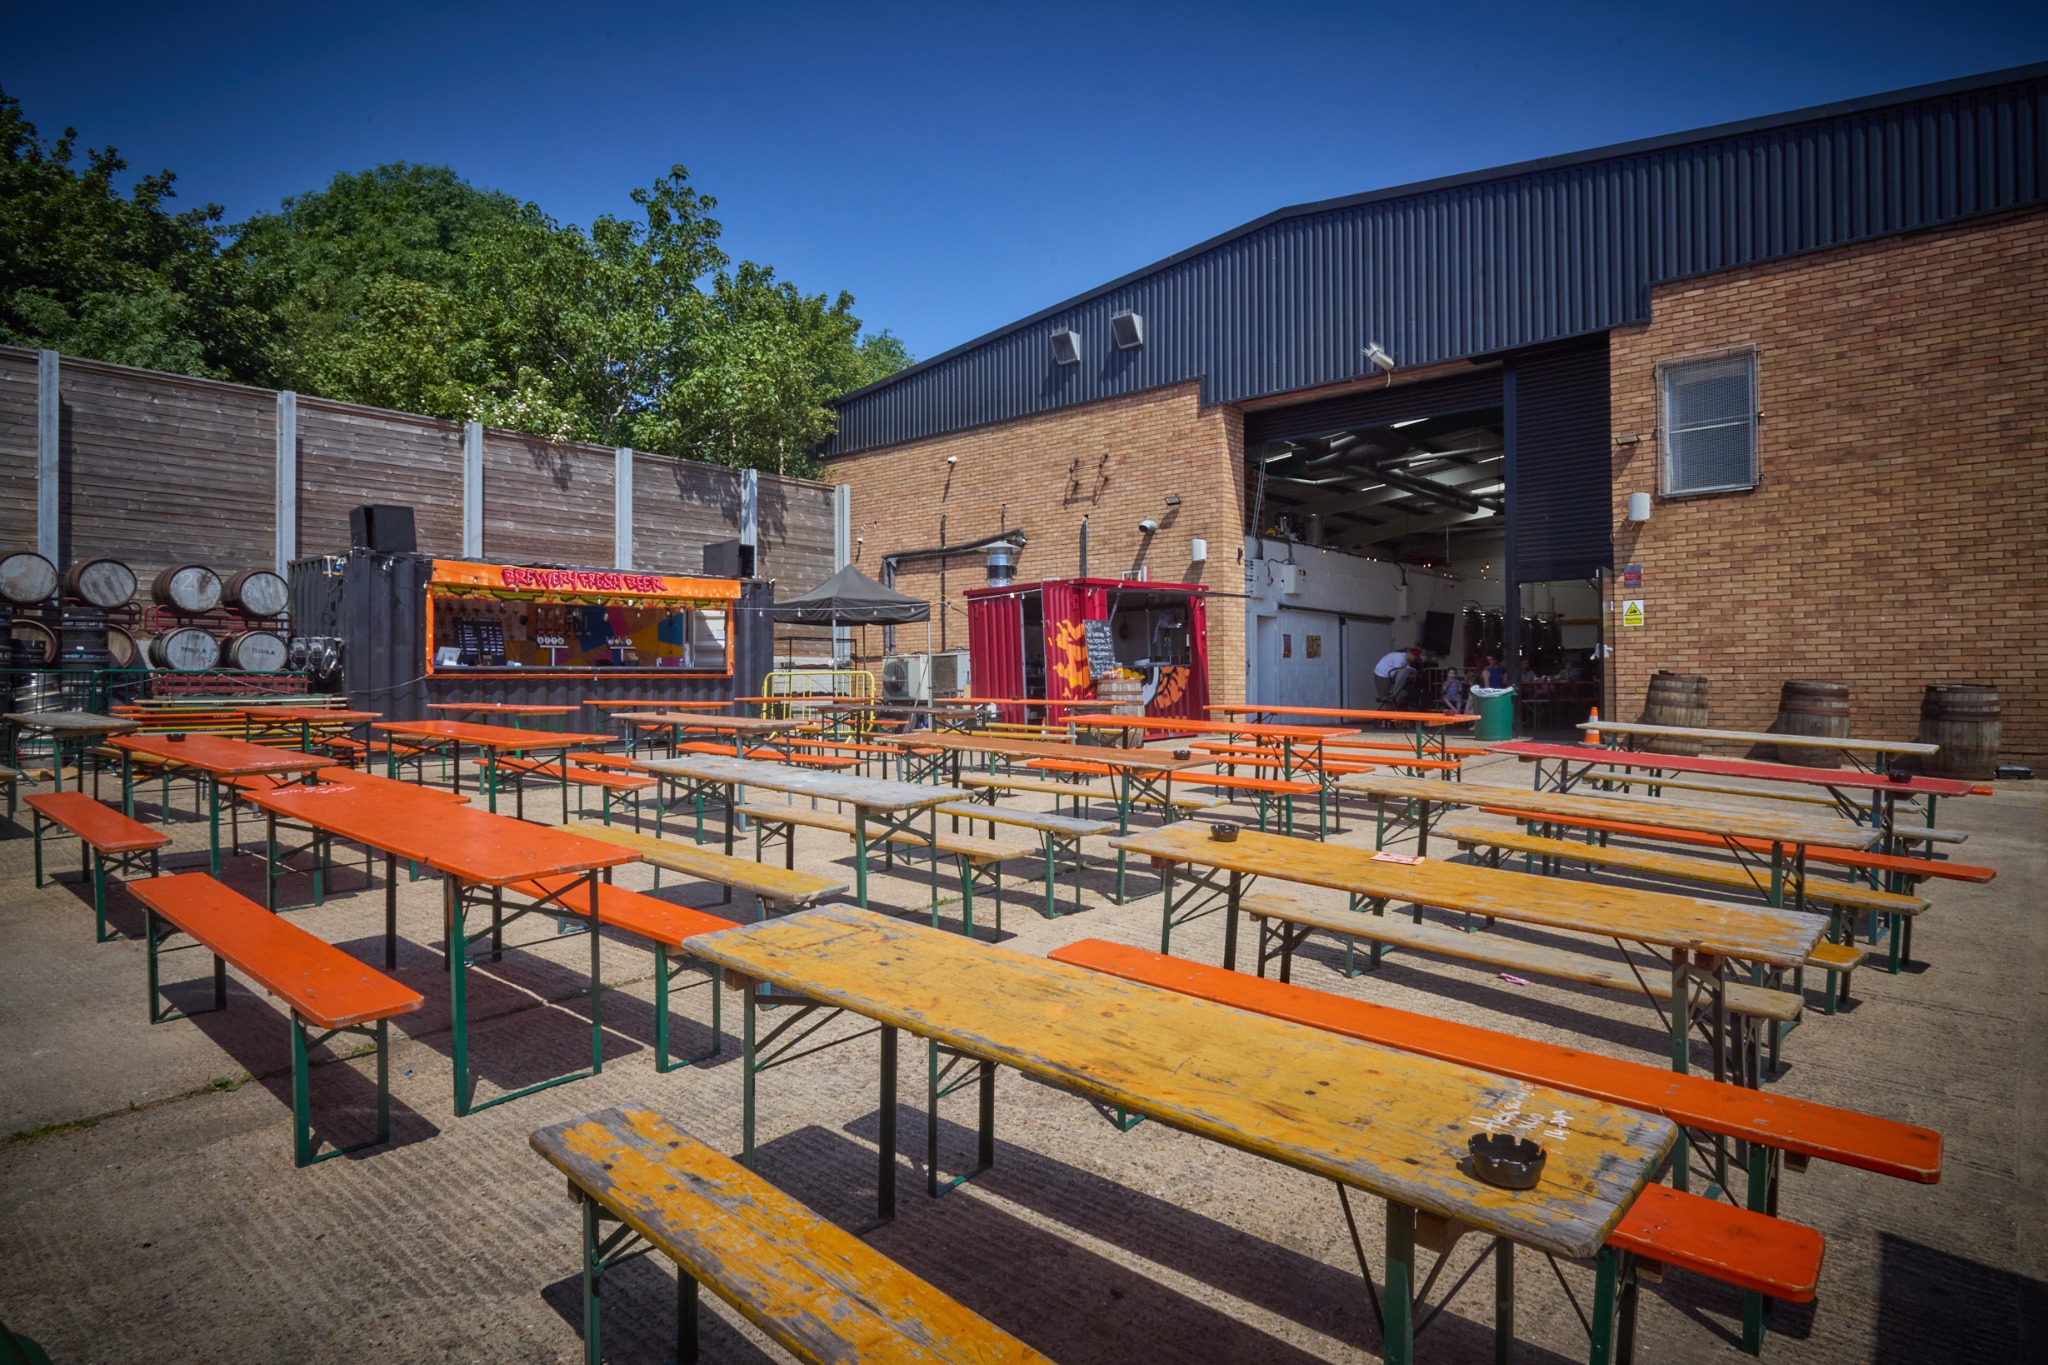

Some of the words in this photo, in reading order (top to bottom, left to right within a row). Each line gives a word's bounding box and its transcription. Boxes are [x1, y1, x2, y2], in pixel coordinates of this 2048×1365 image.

[180, 573, 193, 590] 2
[501, 568, 578, 591] BREWERY
[578, 572, 623, 591] FRESH
[624, 575, 668, 592] BEER
